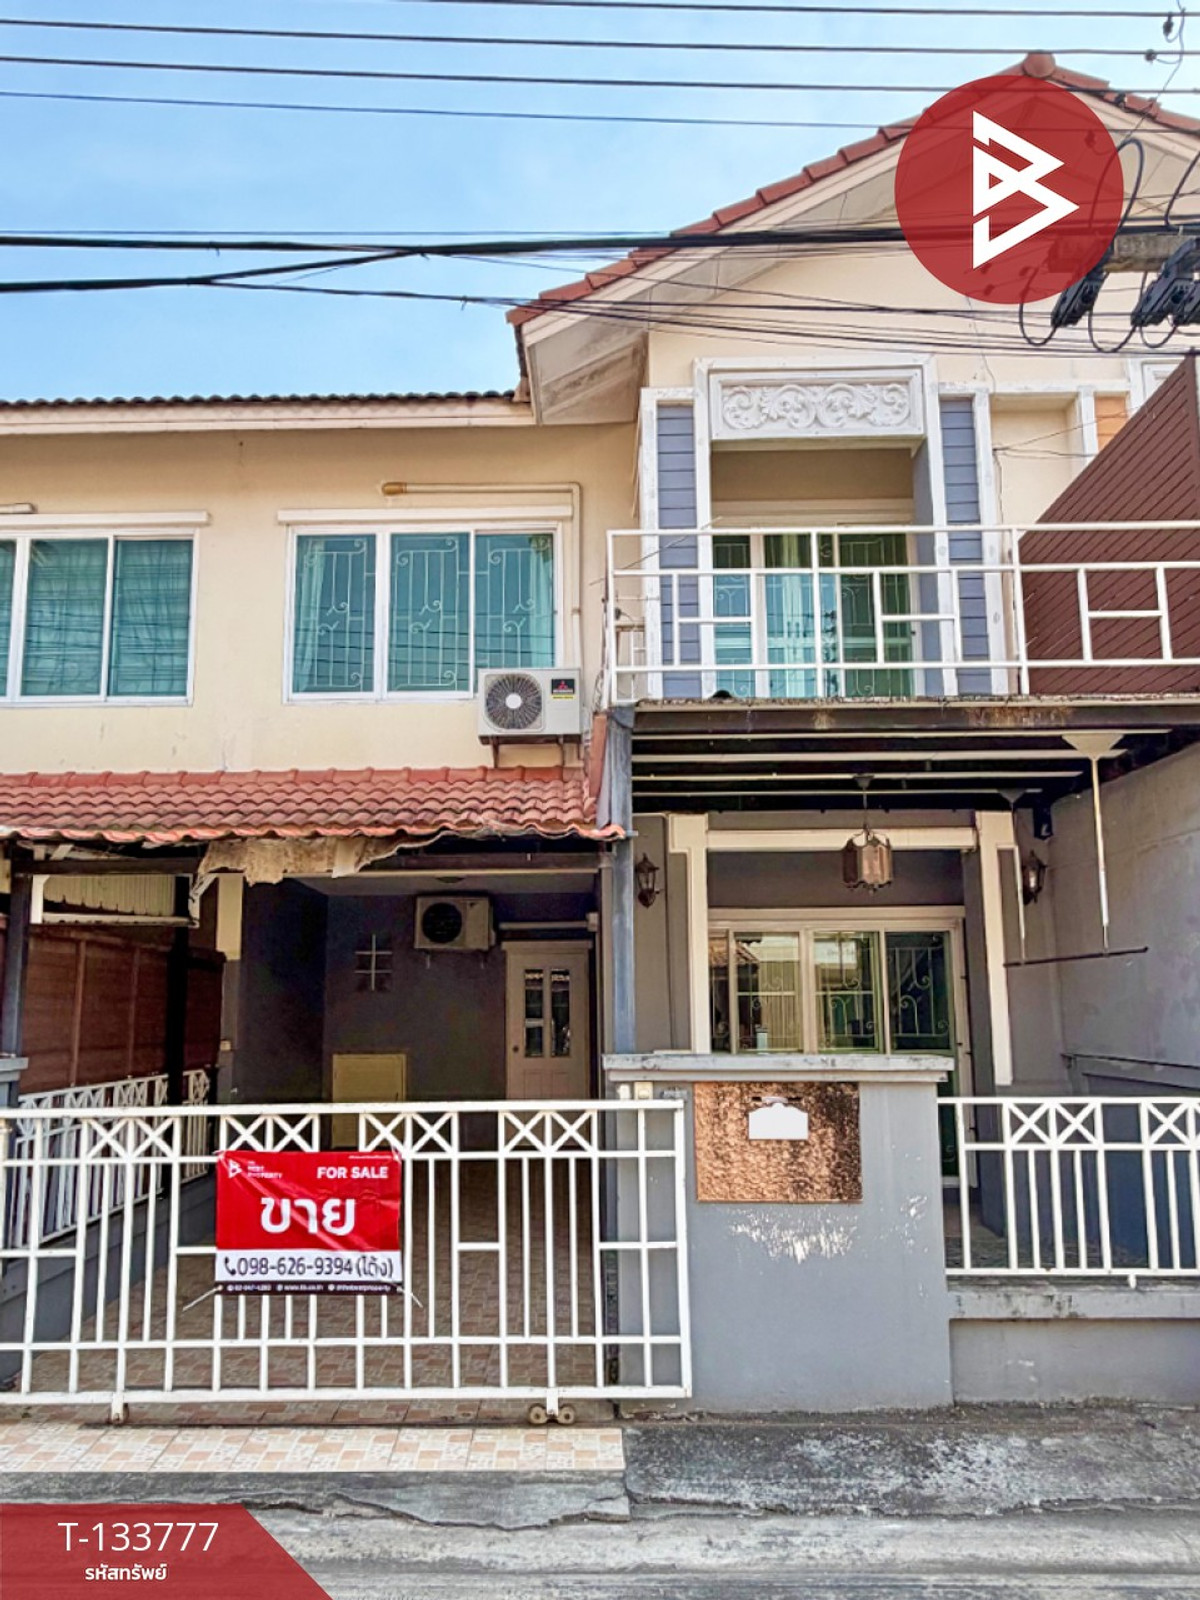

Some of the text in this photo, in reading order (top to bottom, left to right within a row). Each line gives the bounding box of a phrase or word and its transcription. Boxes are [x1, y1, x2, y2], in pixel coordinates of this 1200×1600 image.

[316, 1166, 389, 1179] FOR SALE
[260, 1197, 356, 1236] ขาย
[237, 1257, 353, 1276] 098-626-9394
